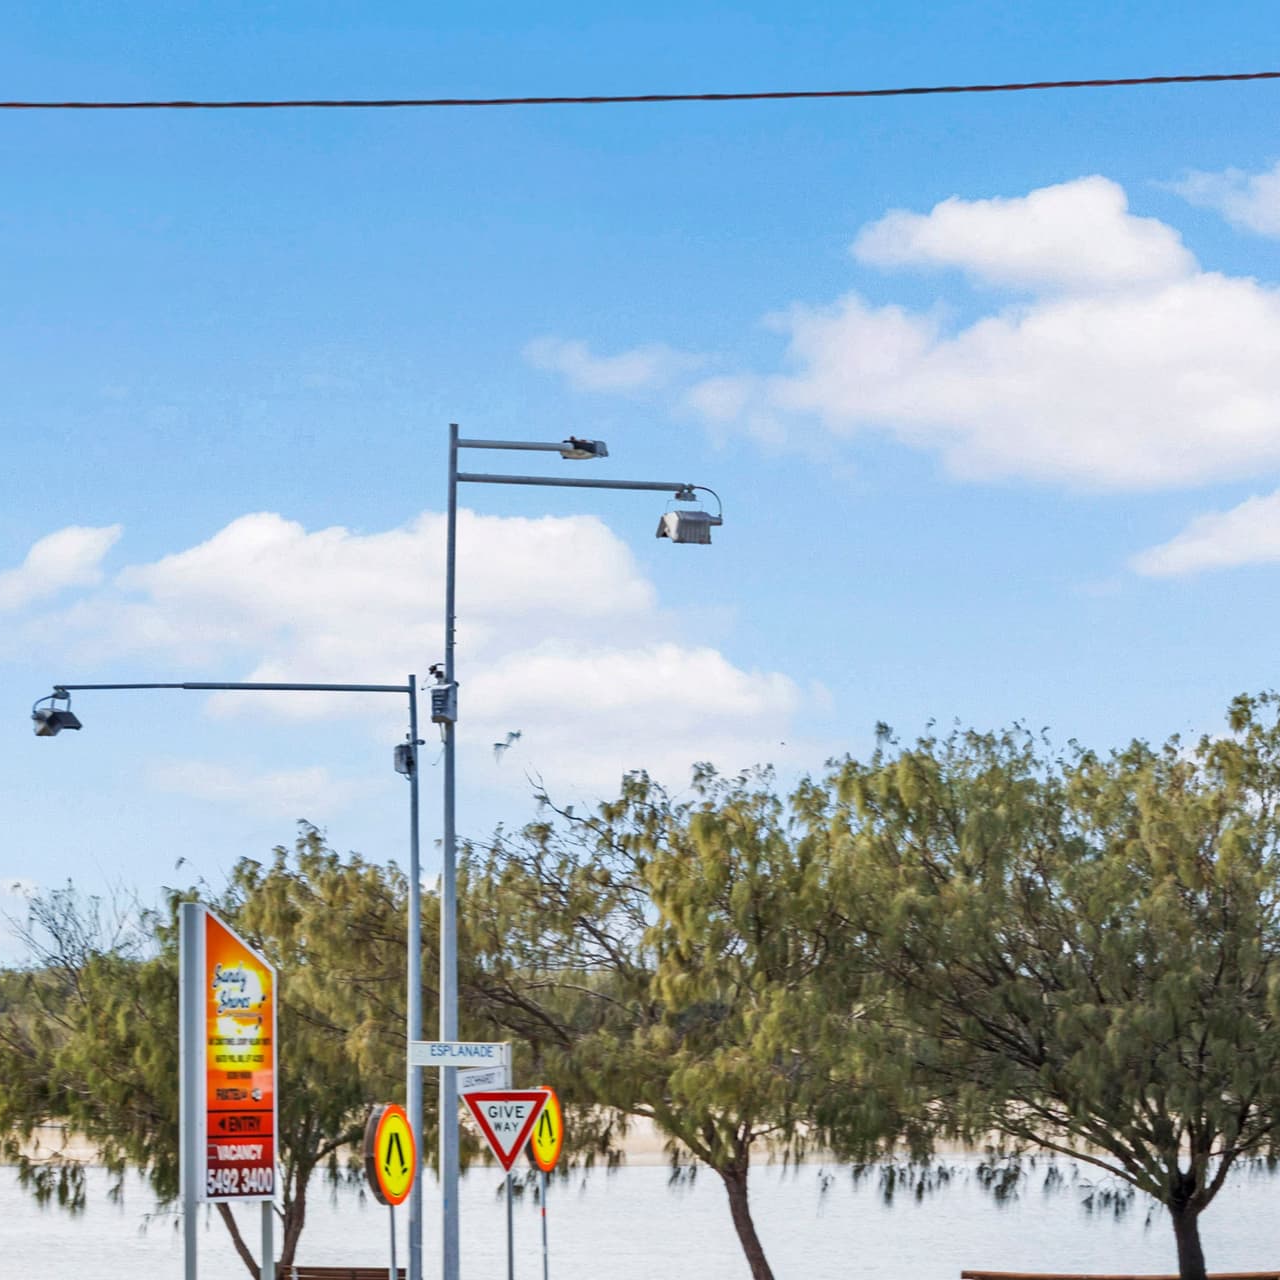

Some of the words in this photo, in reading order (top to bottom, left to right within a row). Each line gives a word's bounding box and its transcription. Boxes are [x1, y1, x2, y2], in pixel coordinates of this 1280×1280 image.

[431, 1045, 494, 1057] ESPLANADE
[488, 1106, 525, 1119] GIVE
[228, 1115, 262, 1132] ENTRY
[494, 1121, 519, 1132] WAY
[216, 1144, 263, 1161] VACANCY
[207, 1168, 239, 1194] 5492
[241, 1167, 273, 1193] 3400
